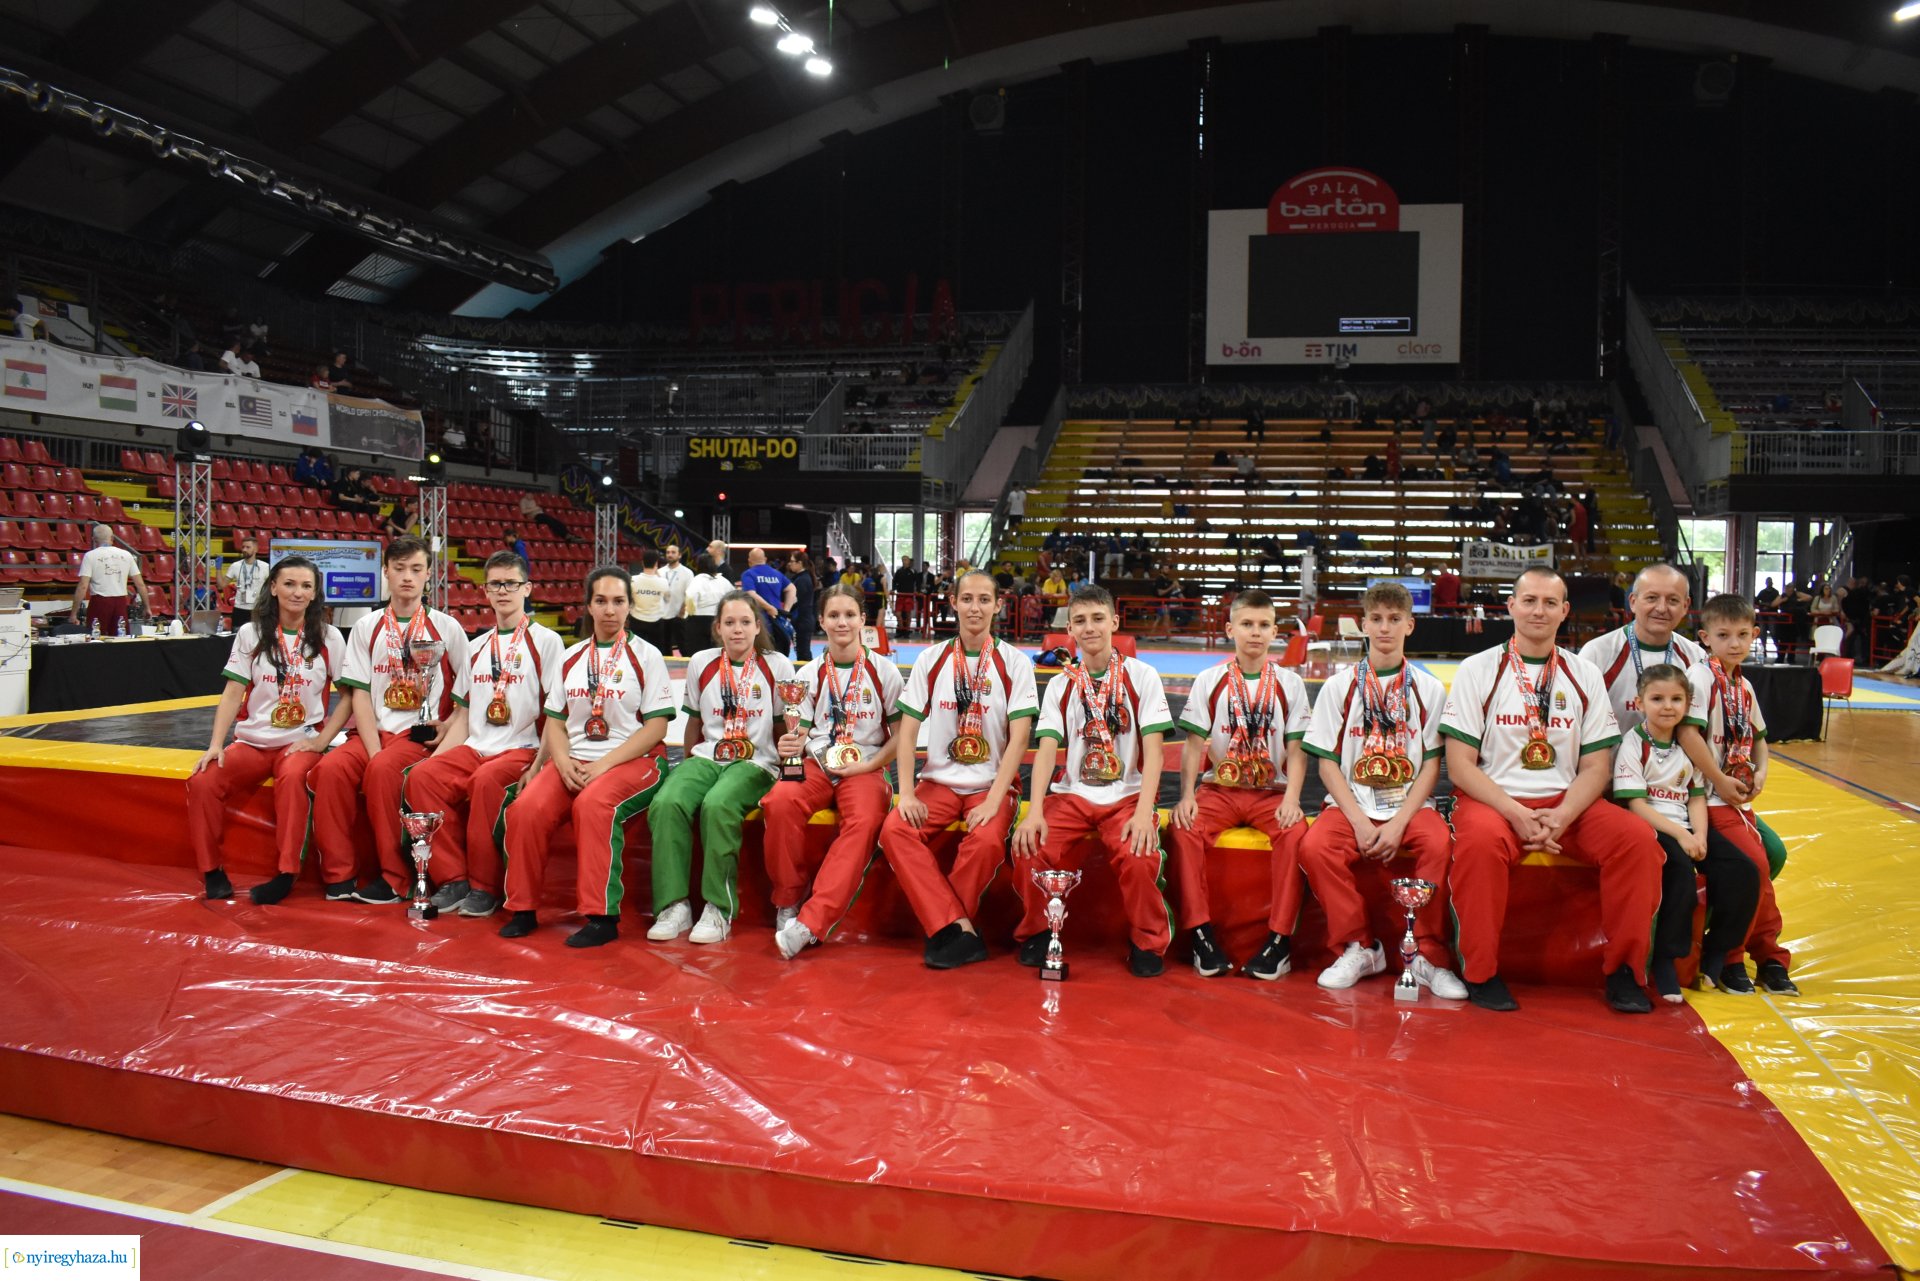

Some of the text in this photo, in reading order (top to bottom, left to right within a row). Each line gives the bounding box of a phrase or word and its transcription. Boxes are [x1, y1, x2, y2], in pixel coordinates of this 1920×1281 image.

[1308, 182, 1359, 196] PALA
[1310, 222, 1356, 230] PERUGIA
[1325, 343, 1357, 357] TIM
[689, 438, 798, 459] SHUTAI-DO
[1493, 545, 1536, 560] SMILE
[757, 576, 779, 584] ITALIA
[473, 674, 525, 684] HUNRY
[567, 687, 626, 700] HUNRY
[1495, 714, 1575, 729] HUNRY
